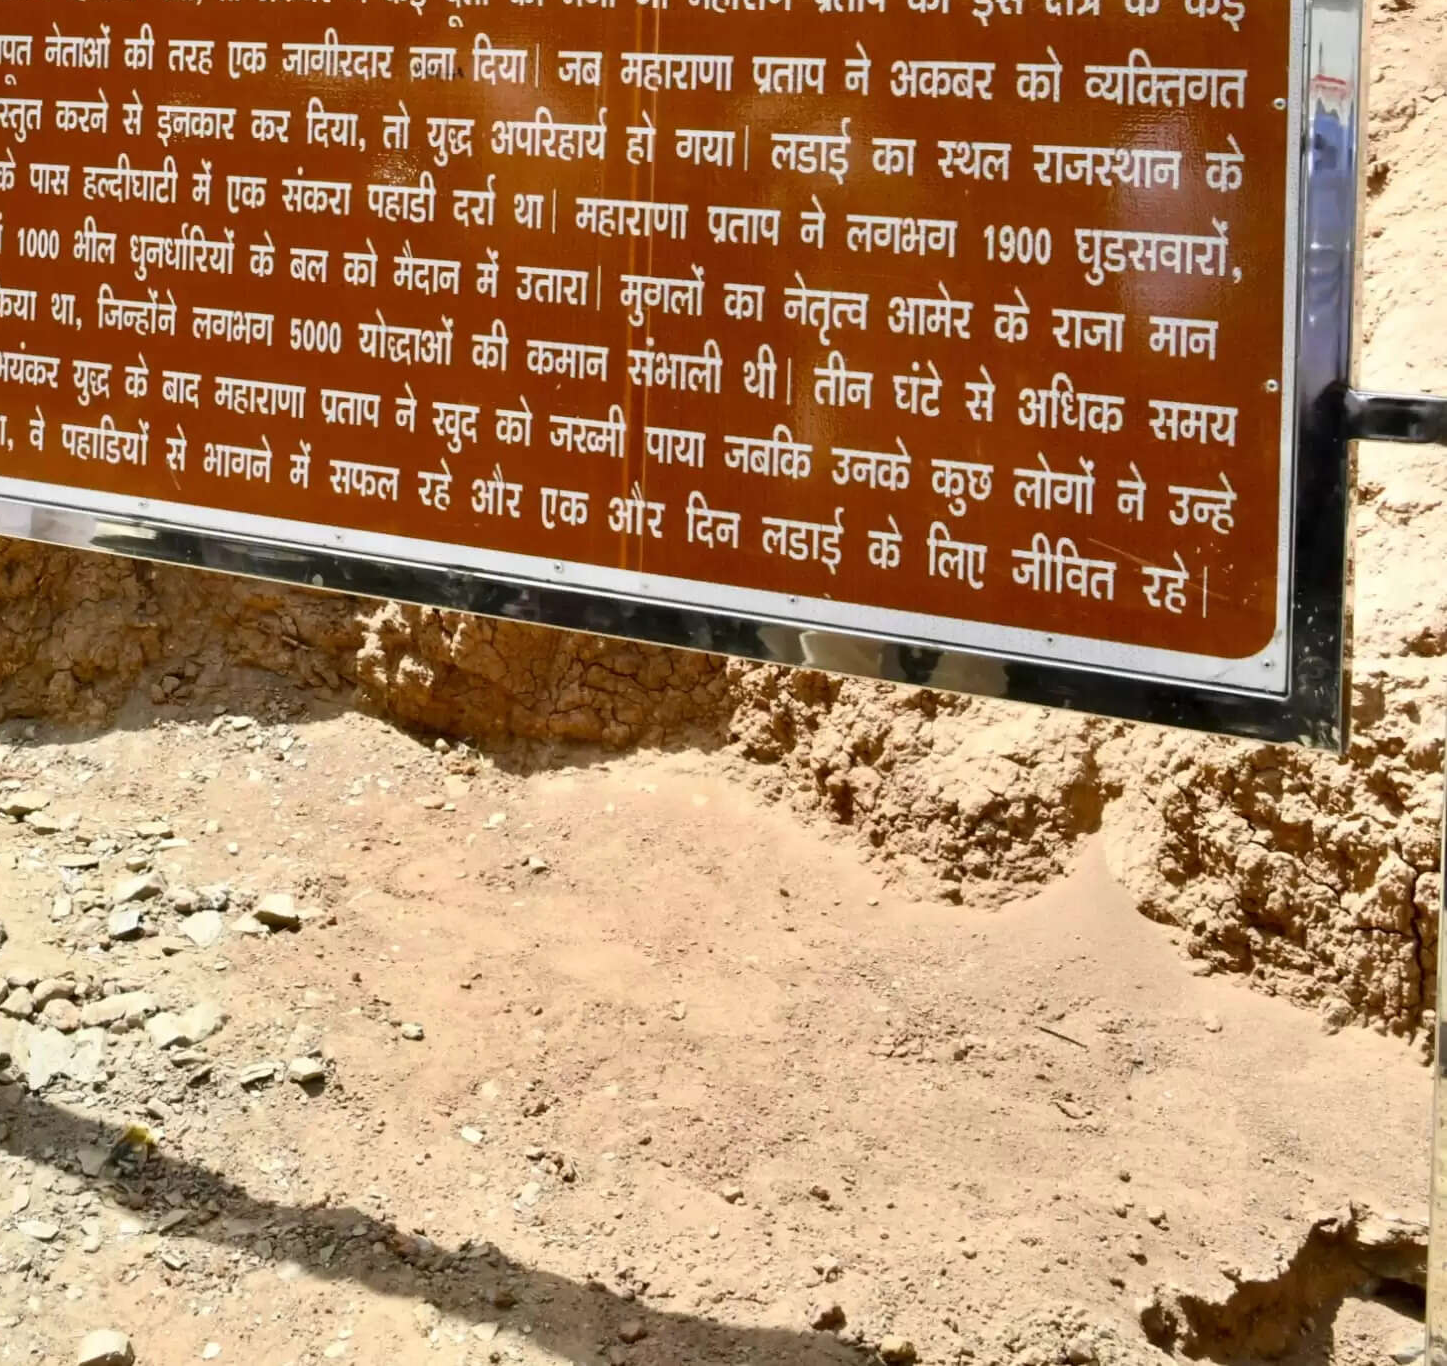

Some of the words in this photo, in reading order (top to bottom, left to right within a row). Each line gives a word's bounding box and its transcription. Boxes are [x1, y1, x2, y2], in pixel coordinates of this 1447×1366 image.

[44, 21, 111, 69] नेताओं
[123, 22, 155, 71] की
[227, 41, 268, 80] एक
[281, 26, 395, 82] जागीरदार
[557, 49, 604, 87] जब
[620, 51, 735, 93] महाराणा
[751, 55, 827, 95] प्रताप
[844, 41, 872, 96] ने
[889, 59, 996, 101] अकबर
[1084, 48, 1249, 109] व्यक्तिगत
[28, 162, 71, 196] पास
[82, 152, 179, 204] हल्दीघाटी
[226, 175, 268, 214] एक
[281, 166, 353, 216] संकरा
[575, 196, 690, 240] महाराणा
[707, 205, 782, 246] प्रताप
[800, 193, 827, 250] ने
[845, 213, 959, 258] लगभग
[983, 224, 1052, 266] 1900
[122, 88, 144, 136] से
[156, 104, 238, 148] इनकार
[305, 96, 367, 152] दिया,
[382, 99, 411, 150] तो
[490, 105, 608, 162] अपरिहार्य
[625, 109, 657, 166] हो
[937, 140, 1013, 182] स्थल
[1032, 144, 1182, 190] राजस्थान
[1205, 133, 1245, 193] के
[72, 215, 118, 265] भील
[289, 247, 330, 283] बल
[393, 239, 462, 296] मैदान
[476, 246, 500, 299] में
[619, 263, 706, 328] मुगलों
[783, 270, 870, 347] नेतृत्व
[887, 280, 975, 340] आमेर
[993, 286, 1031, 344] के
[1051, 308, 1126, 353] राजा
[1148, 315, 1219, 361] मान
[50, 292, 83, 331] था,
[97, 282, 178, 337] जिन्होंने
[192, 306, 275, 347] लगभग
[358, 307, 454, 366] योद्धाओं
[471, 318, 510, 372] की
[526, 339, 610, 382] कमान
[627, 336, 724, 394] संभाली
[892, 359, 943, 418] घंटे
[1018, 372, 1126, 435] अधिक
[1148, 399, 1240, 447] समय
[71, 359, 113, 407] युद्ध
[161, 369, 203, 409] बाद
[214, 376, 307, 419] महाराणा
[320, 388, 382, 429] प्रताप
[432, 401, 481, 454] खुद
[643, 426, 707, 469] पाया
[723, 423, 814, 480] जबकि
[830, 435, 912, 492] उनके
[930, 458, 995, 517] कुछ
[1012, 451, 1096, 515] लोगों
[1116, 460, 1147, 522] ने
[1167, 471, 1238, 535] उन्हे
[165, 423, 188, 472] से
[203, 434, 273, 484] भागने
[328, 459, 401, 502] सफल
[417, 457, 453, 511] रहे
[540, 486, 590, 530] एक
[685, 490, 742, 549] दिन
[926, 520, 988, 590] लिए
[1011, 532, 1118, 601] जीवित
